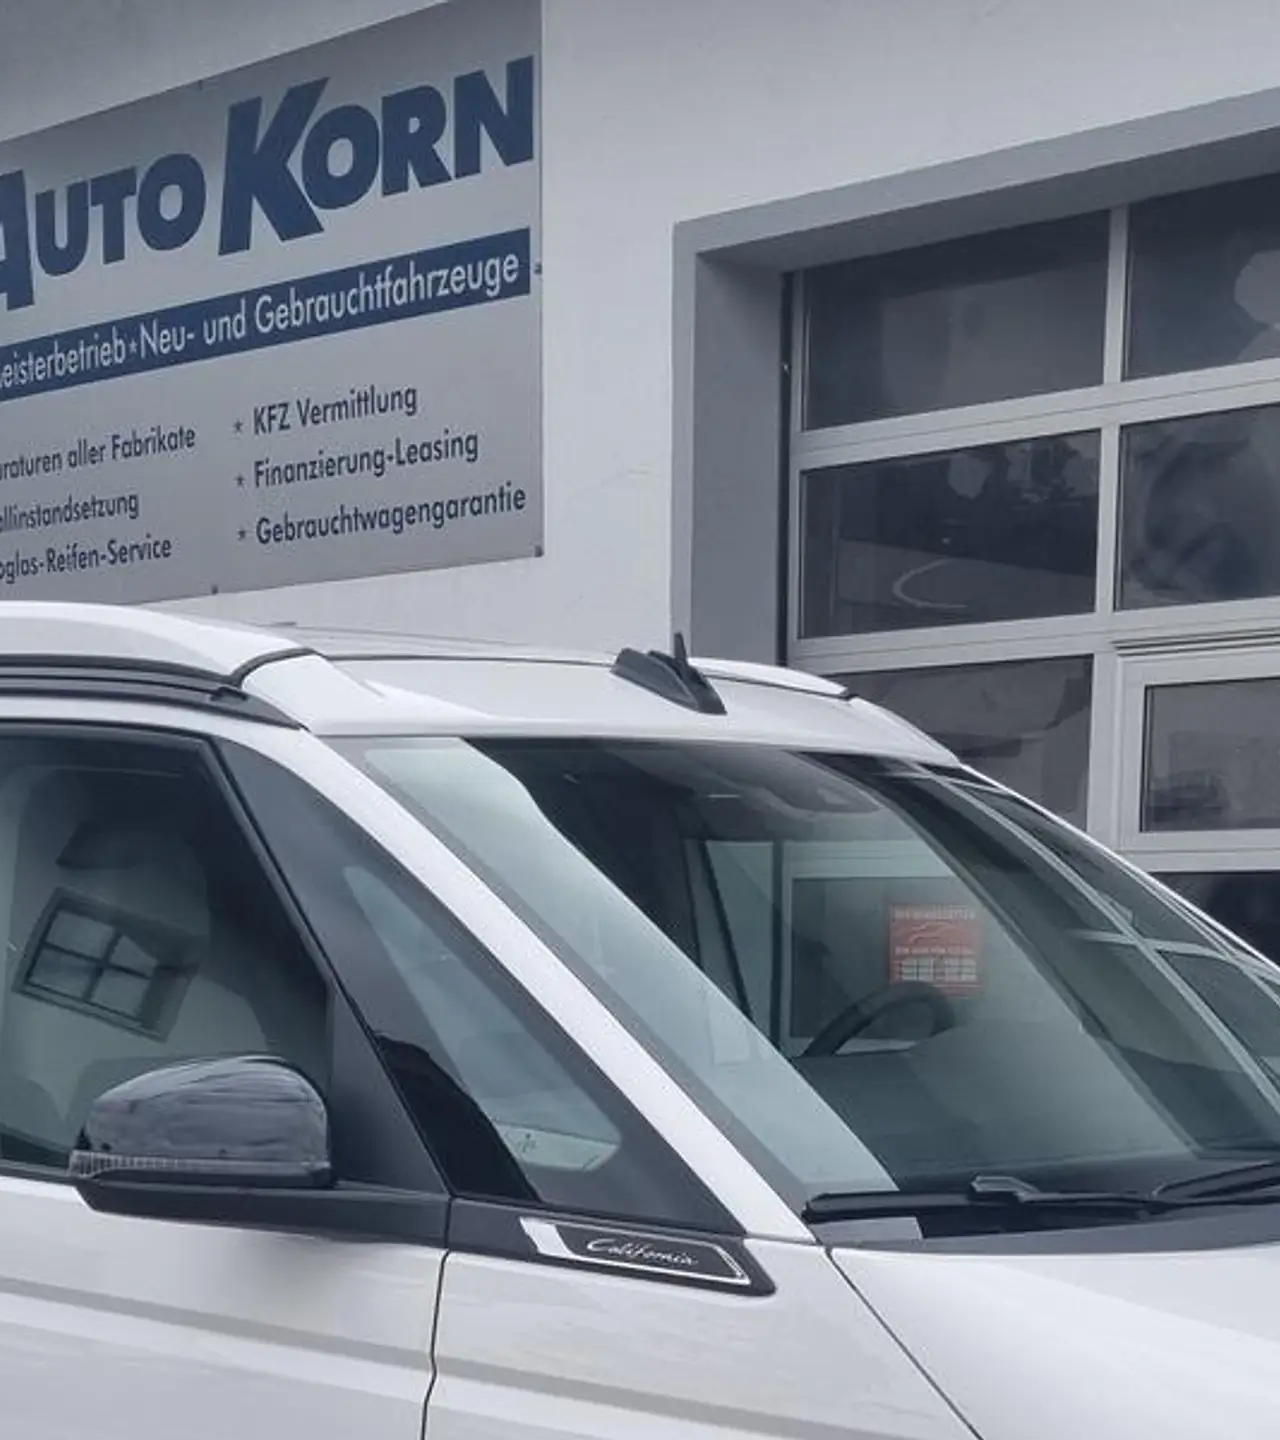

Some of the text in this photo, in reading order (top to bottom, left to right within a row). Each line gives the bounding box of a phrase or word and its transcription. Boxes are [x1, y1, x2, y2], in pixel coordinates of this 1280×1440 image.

[219, 56, 533, 256] KORN
[203, 298, 246, 347] und
[255, 253, 519, 333] Gebrauchtfahrzeuge
[254, 385, 417, 435] KFZ Vermittlung
[67, 439, 106, 469] aller
[111, 426, 196, 462] Fabrikate
[255, 428, 478, 488] Finanzierung-Leasing
[256, 481, 526, 544] Gebrauchtwagengarantie
